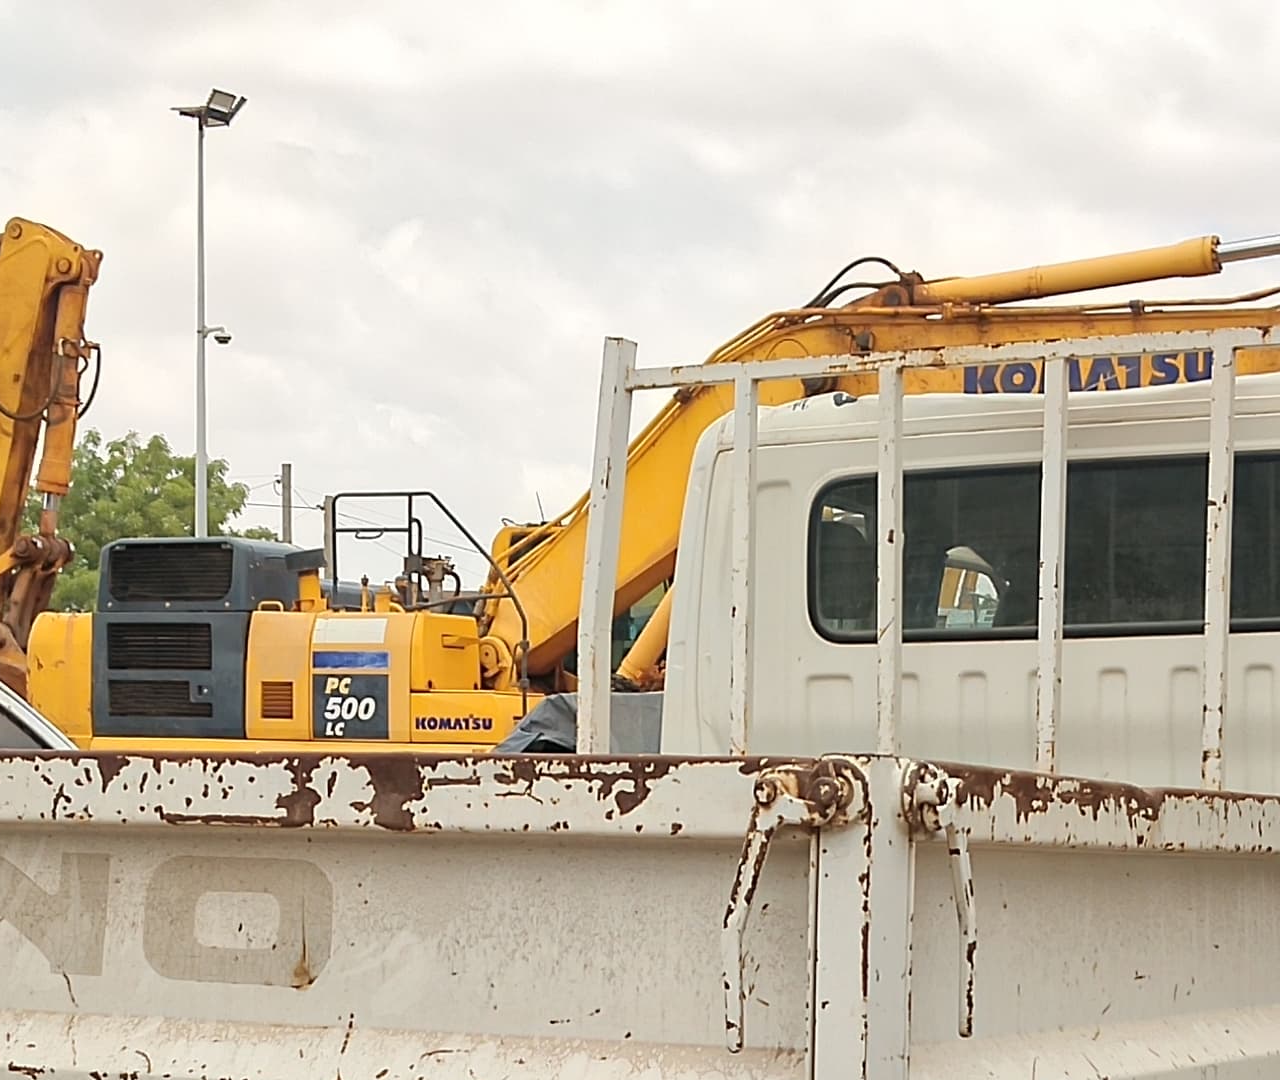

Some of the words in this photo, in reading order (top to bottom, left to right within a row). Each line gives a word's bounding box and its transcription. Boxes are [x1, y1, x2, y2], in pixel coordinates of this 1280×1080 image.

[324, 677, 353, 695] PC
[323, 696, 377, 721] 500
[324, 721, 346, 737] LC
[415, 714, 493, 731] KOMATSU
